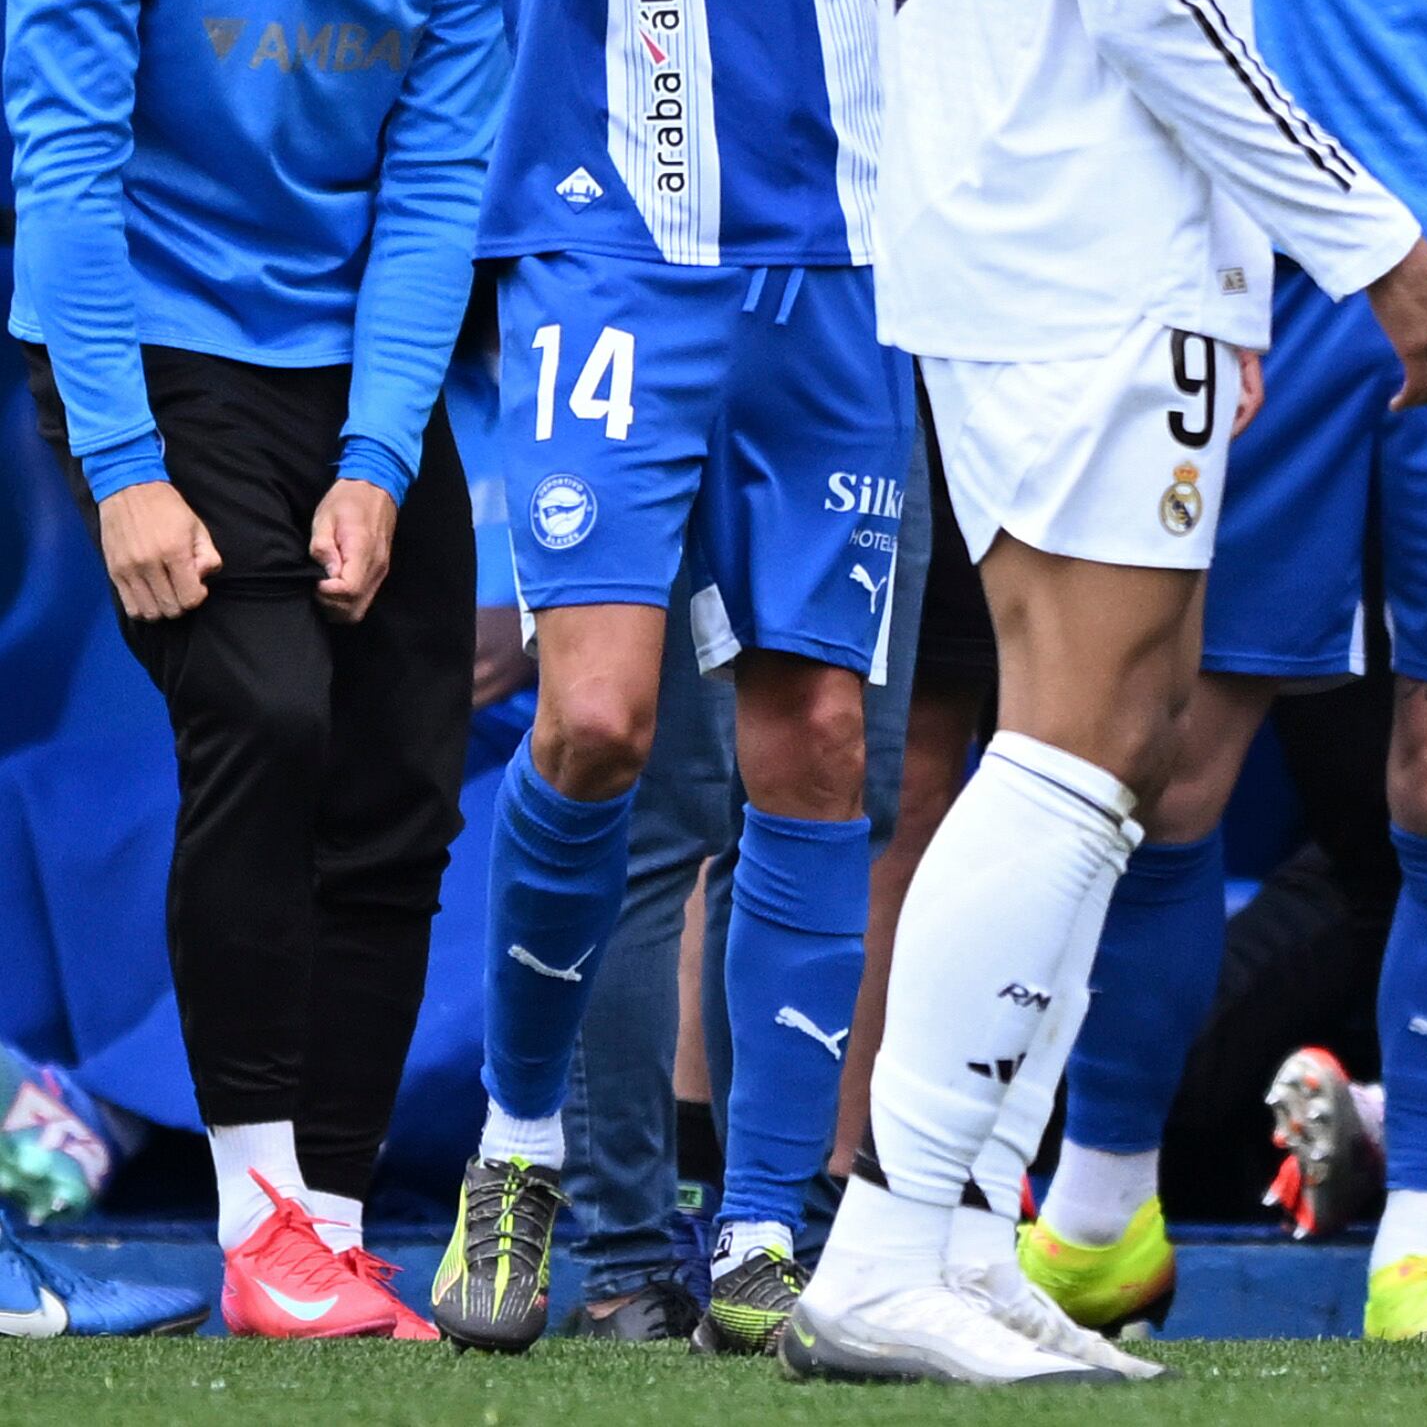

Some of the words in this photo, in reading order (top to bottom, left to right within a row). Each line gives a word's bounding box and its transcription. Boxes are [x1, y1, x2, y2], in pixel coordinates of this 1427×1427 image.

[646, 72, 685, 193] araba
[532, 324, 635, 442] 14
[1167, 329, 1216, 449] 9
